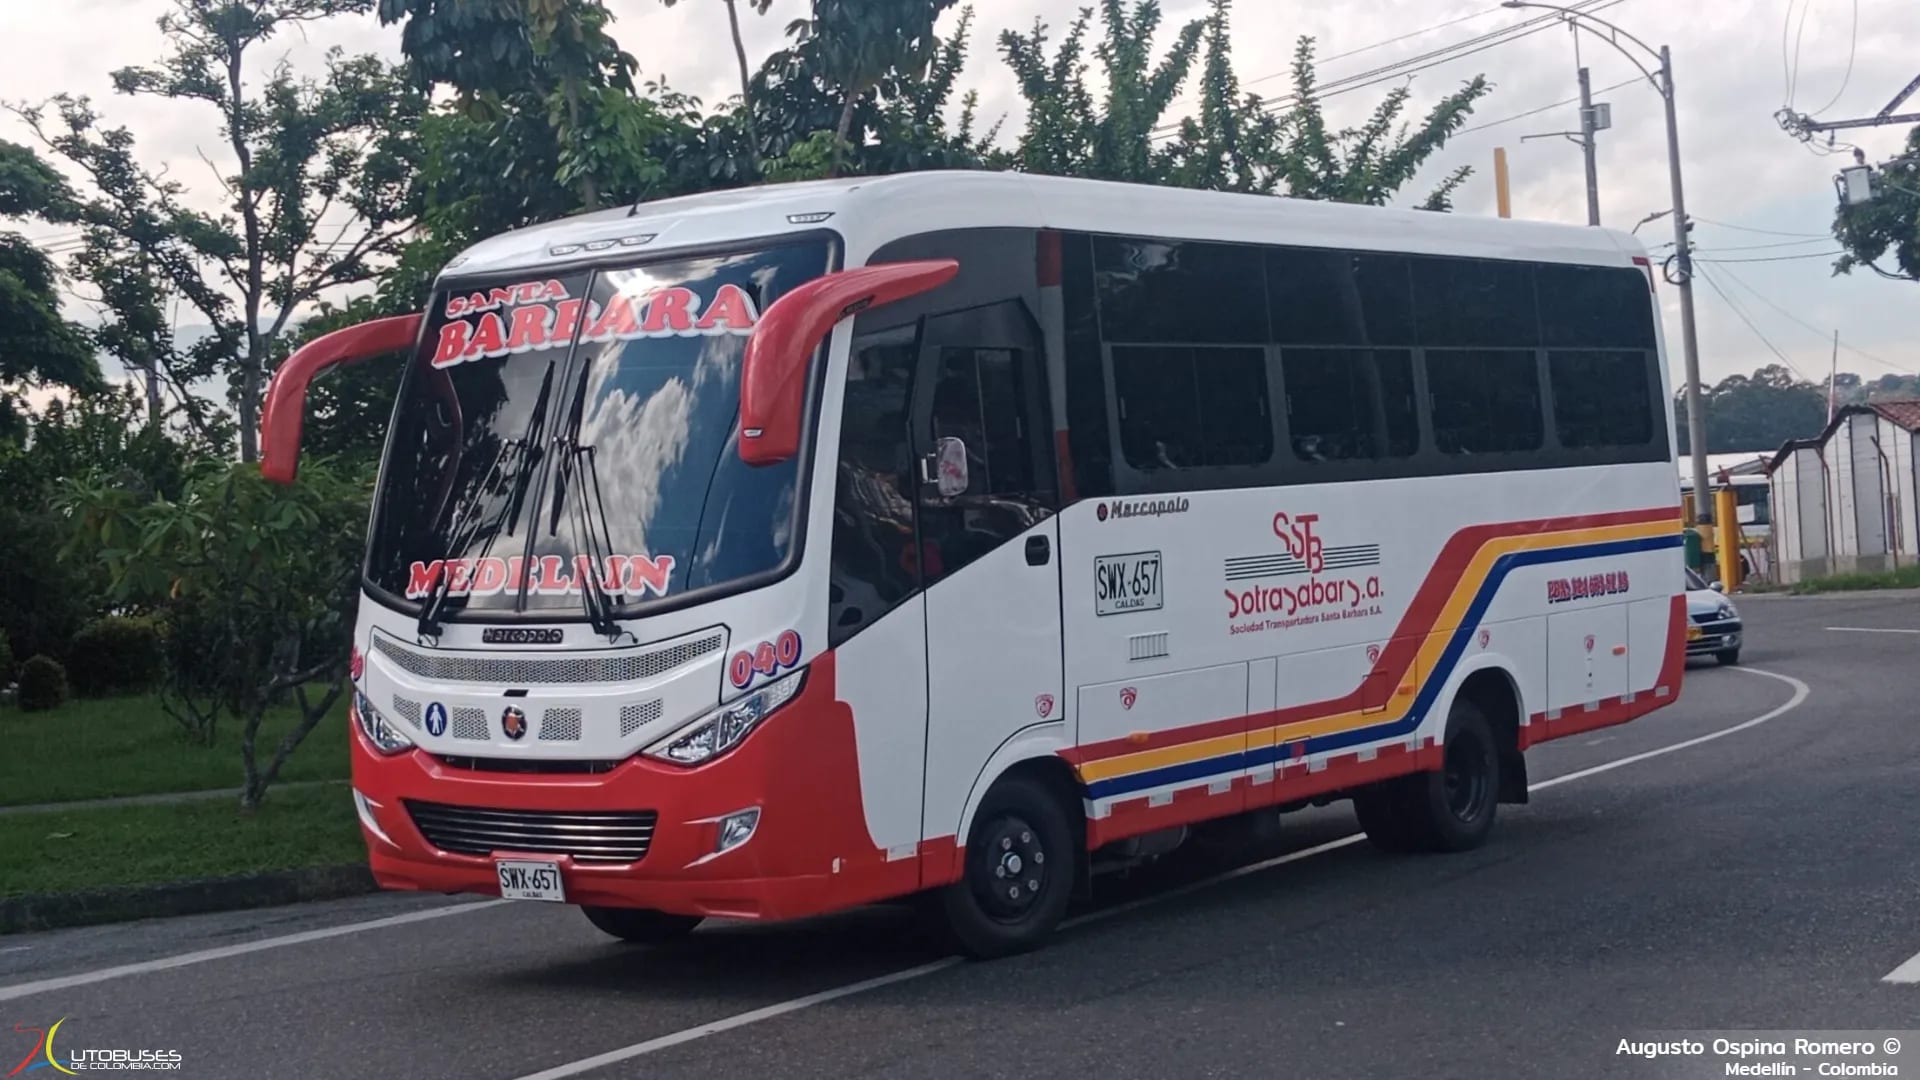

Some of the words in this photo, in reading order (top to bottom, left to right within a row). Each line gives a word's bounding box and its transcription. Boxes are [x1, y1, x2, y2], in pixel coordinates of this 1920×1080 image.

[445, 279, 570, 318] SANTA
[431, 284, 758, 369] BARBARA
[1111, 496, 1189, 519] Marcopolo
[1115, 598, 1144, 609] CALDAS
[1230, 621, 1264, 635] Sociedad
[1265, 614, 1319, 631] Transportadora
[1321, 609, 1341, 622] Santa
[1369, 605, 1383, 615] S.A.
[729, 629, 802, 690] 040
